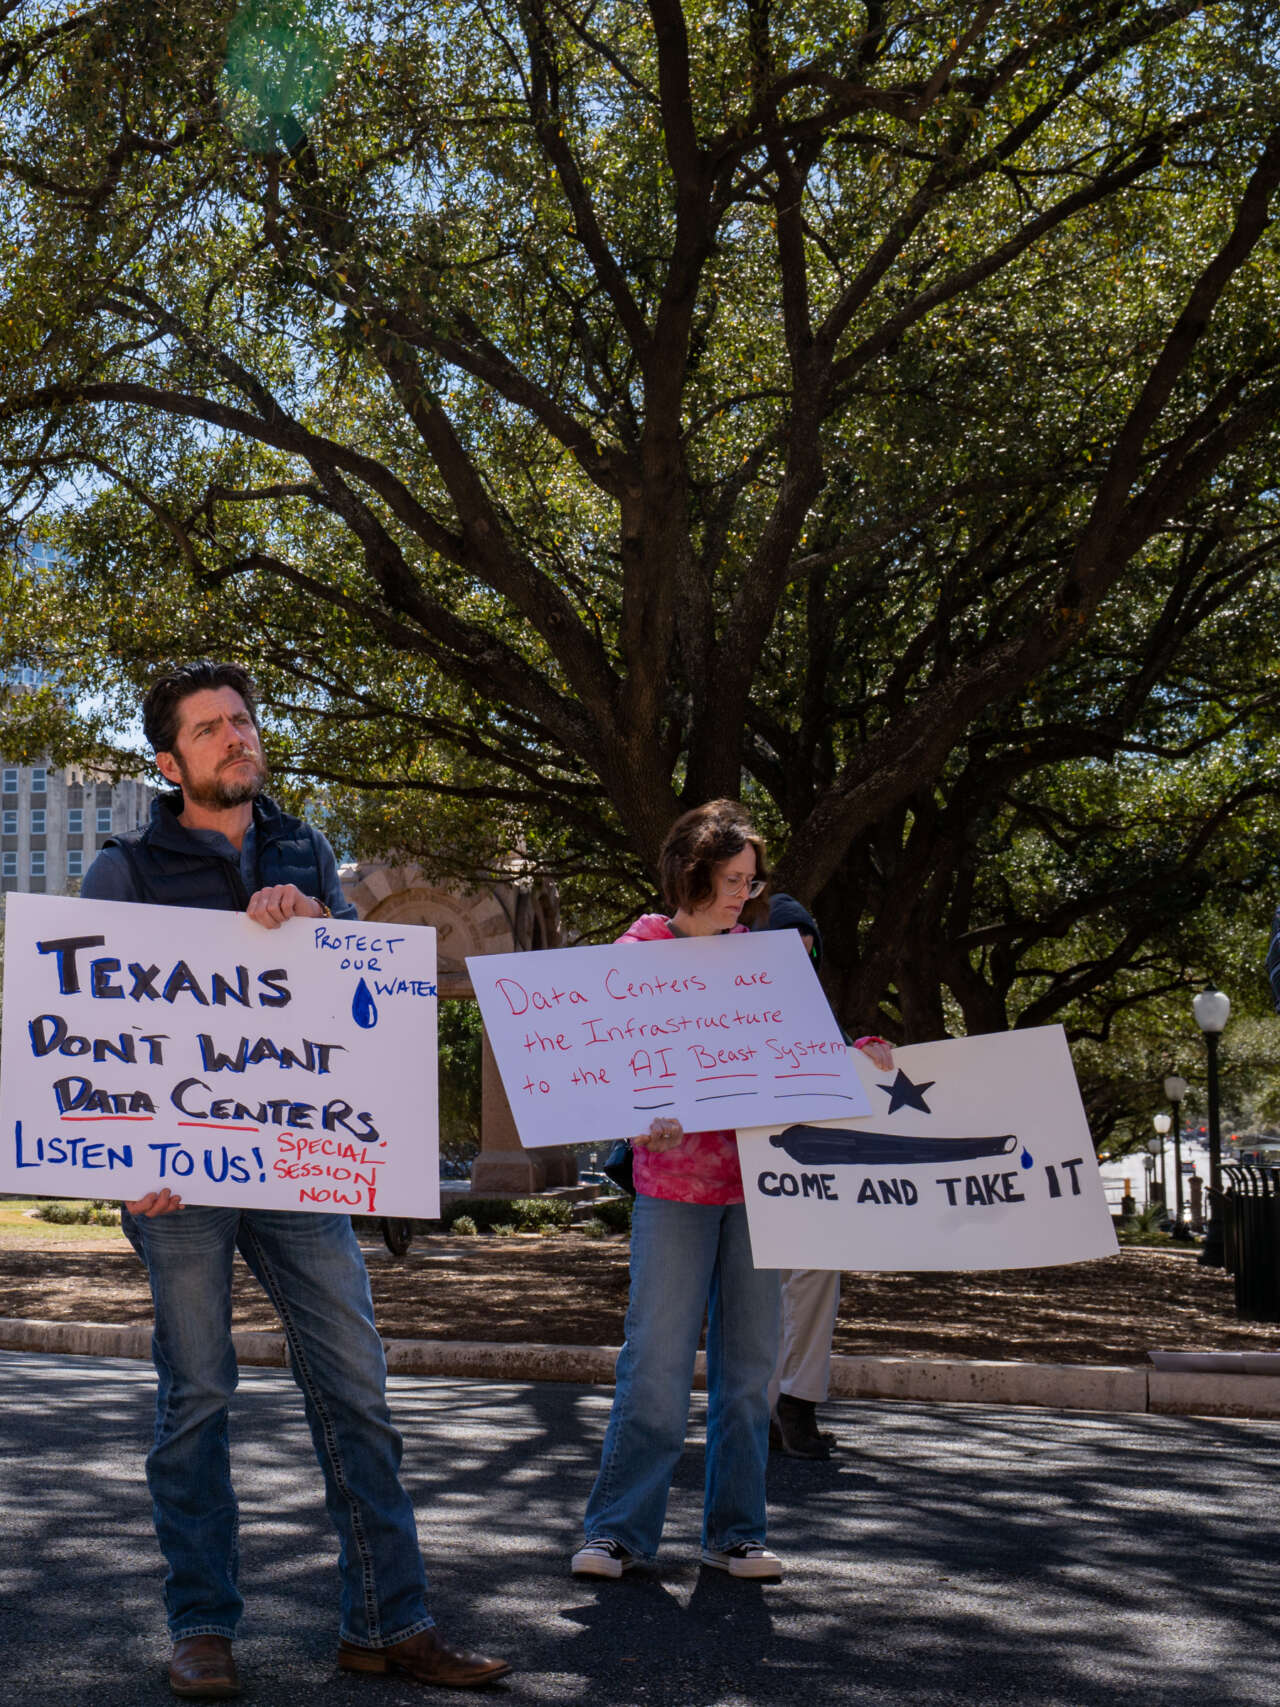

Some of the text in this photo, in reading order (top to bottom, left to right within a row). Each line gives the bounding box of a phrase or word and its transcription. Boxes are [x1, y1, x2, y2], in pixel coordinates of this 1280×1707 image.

[315, 927, 406, 954] PROTECT
[36, 935, 292, 1008] TEXANS
[340, 957, 382, 972] OUR
[375, 978, 438, 997] WATER
[496, 968, 773, 1016] Data Centers are
[29, 1014, 349, 1074] DON'T WANT
[524, 1008, 784, 1054] the Infrastructure
[523, 1037, 850, 1096] to the AI Beast System
[53, 1076, 158, 1114] DATA
[15, 1120, 266, 1183] LISTEN TO US!
[277, 1132, 385, 1165] SPECIAL
[273, 1159, 376, 1187] SESSION
[757, 1158, 1083, 1206] COME AND TAKE IT
[299, 1187, 376, 1212] NOW!
